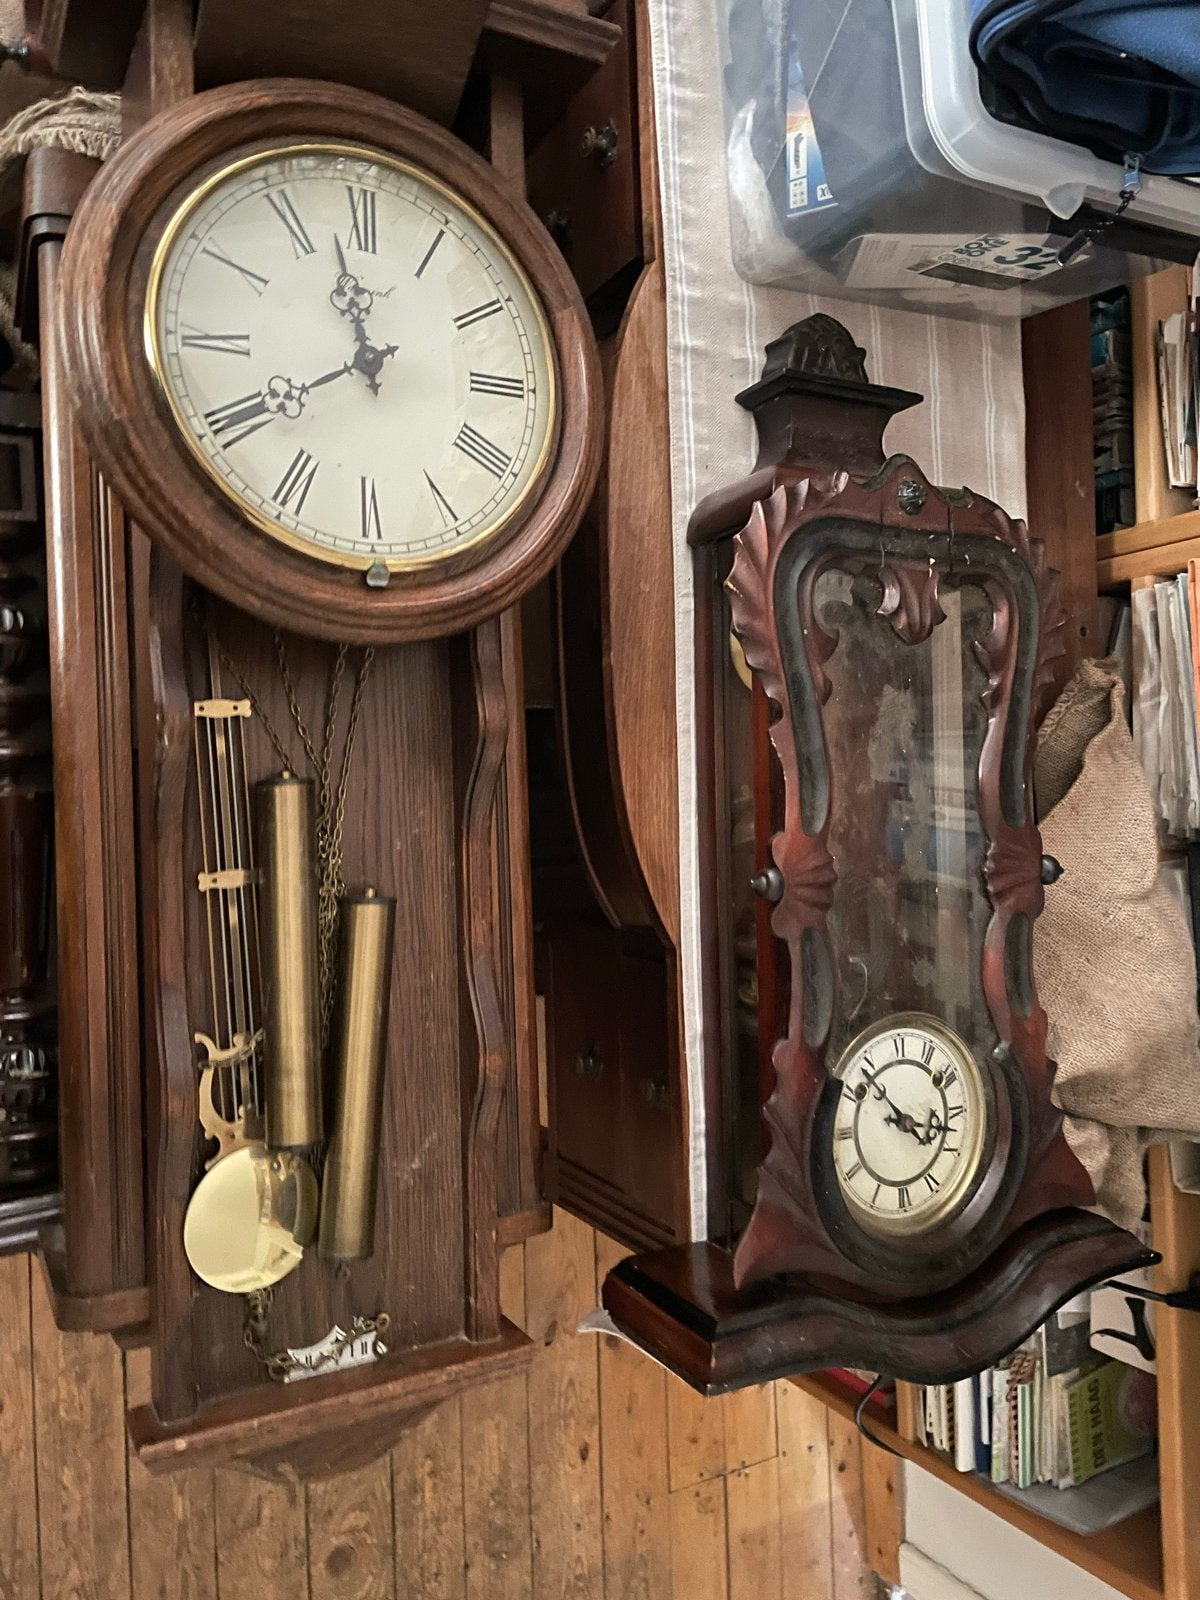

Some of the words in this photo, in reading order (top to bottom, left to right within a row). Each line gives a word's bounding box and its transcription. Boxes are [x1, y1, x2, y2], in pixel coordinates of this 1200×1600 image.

[264, 189, 314, 259] XI
[347, 185, 376, 254] XII
[952, 233, 1001, 254] BOX
[200, 237, 270, 296] X
[414, 229, 446, 279] I
[181, 323, 251, 358] IX
[453, 298, 504, 331] II
[470, 371, 524, 399] III
[452, 423, 512, 479] IIII
[271, 448, 320, 516] VII
[360, 476, 382, 539] VI
[423, 469, 460, 528] V
